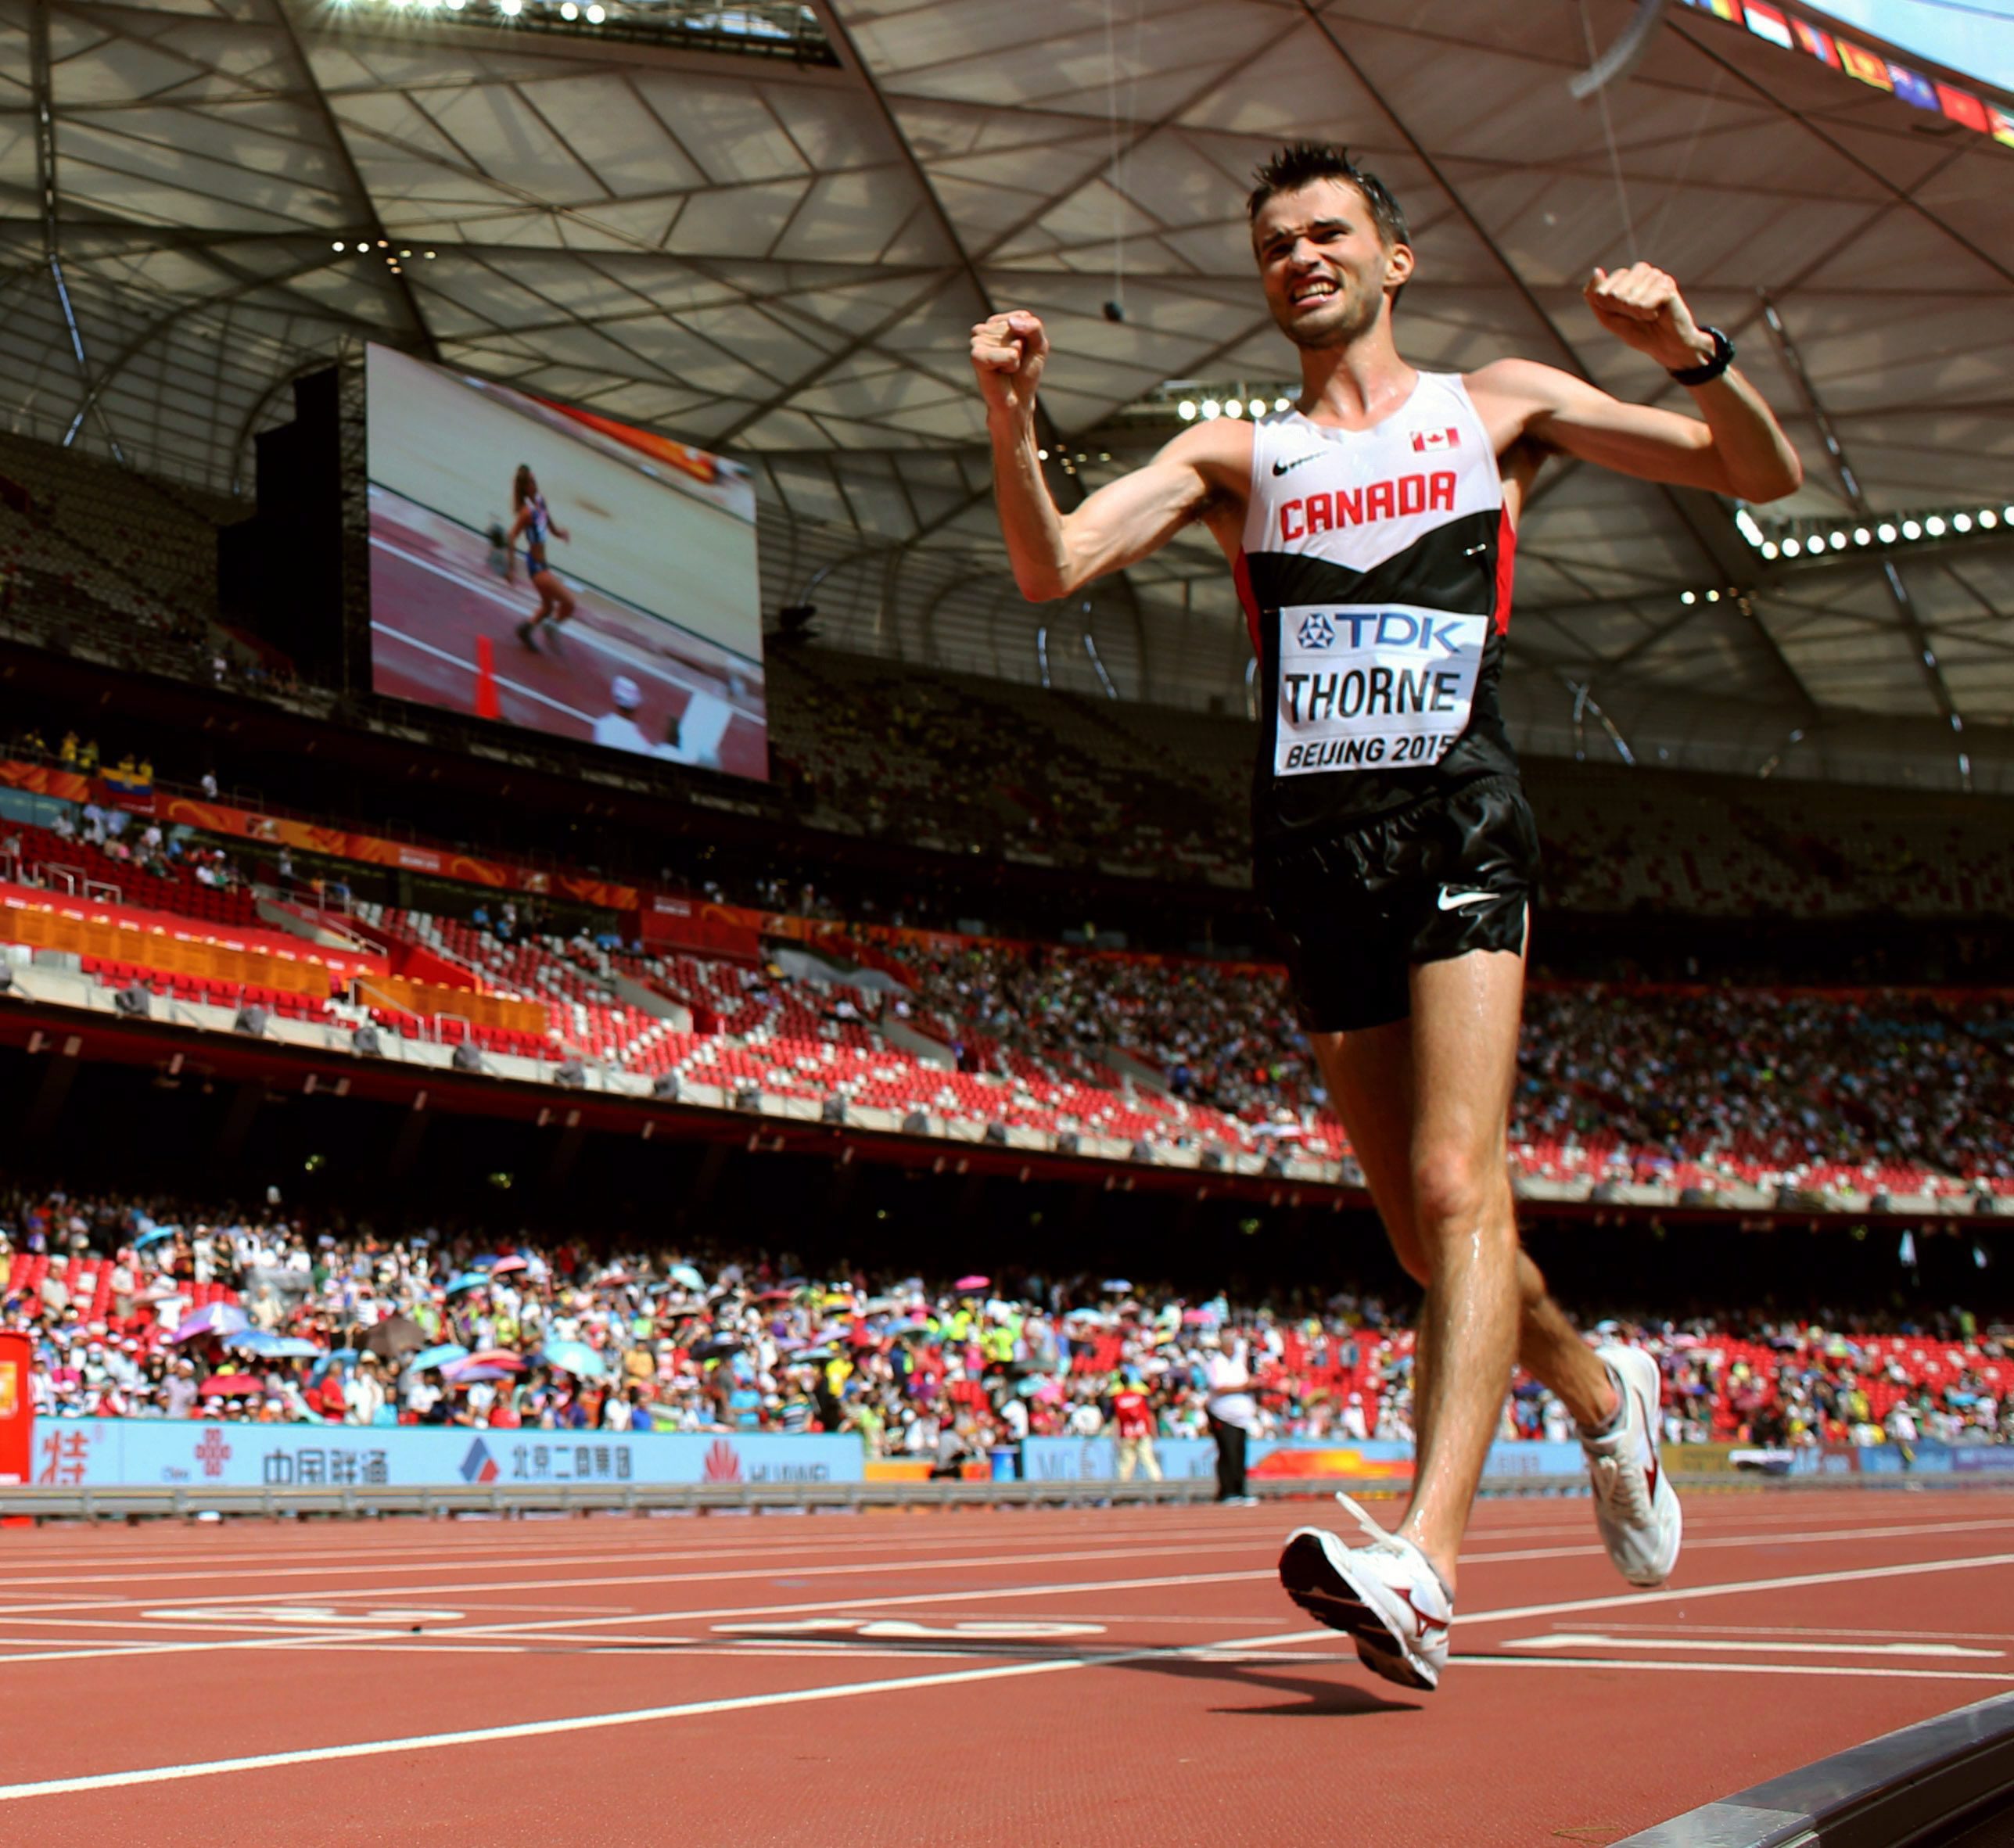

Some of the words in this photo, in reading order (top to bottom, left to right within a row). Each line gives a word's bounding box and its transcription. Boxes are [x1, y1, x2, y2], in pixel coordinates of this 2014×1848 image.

[1280, 470, 1457, 543] CANADA
[1335, 612, 1467, 653] TDK
[1284, 666, 1461, 723] THORNE
[1286, 737, 1384, 770] BEIJING
[1391, 734, 1456, 762] 2015
